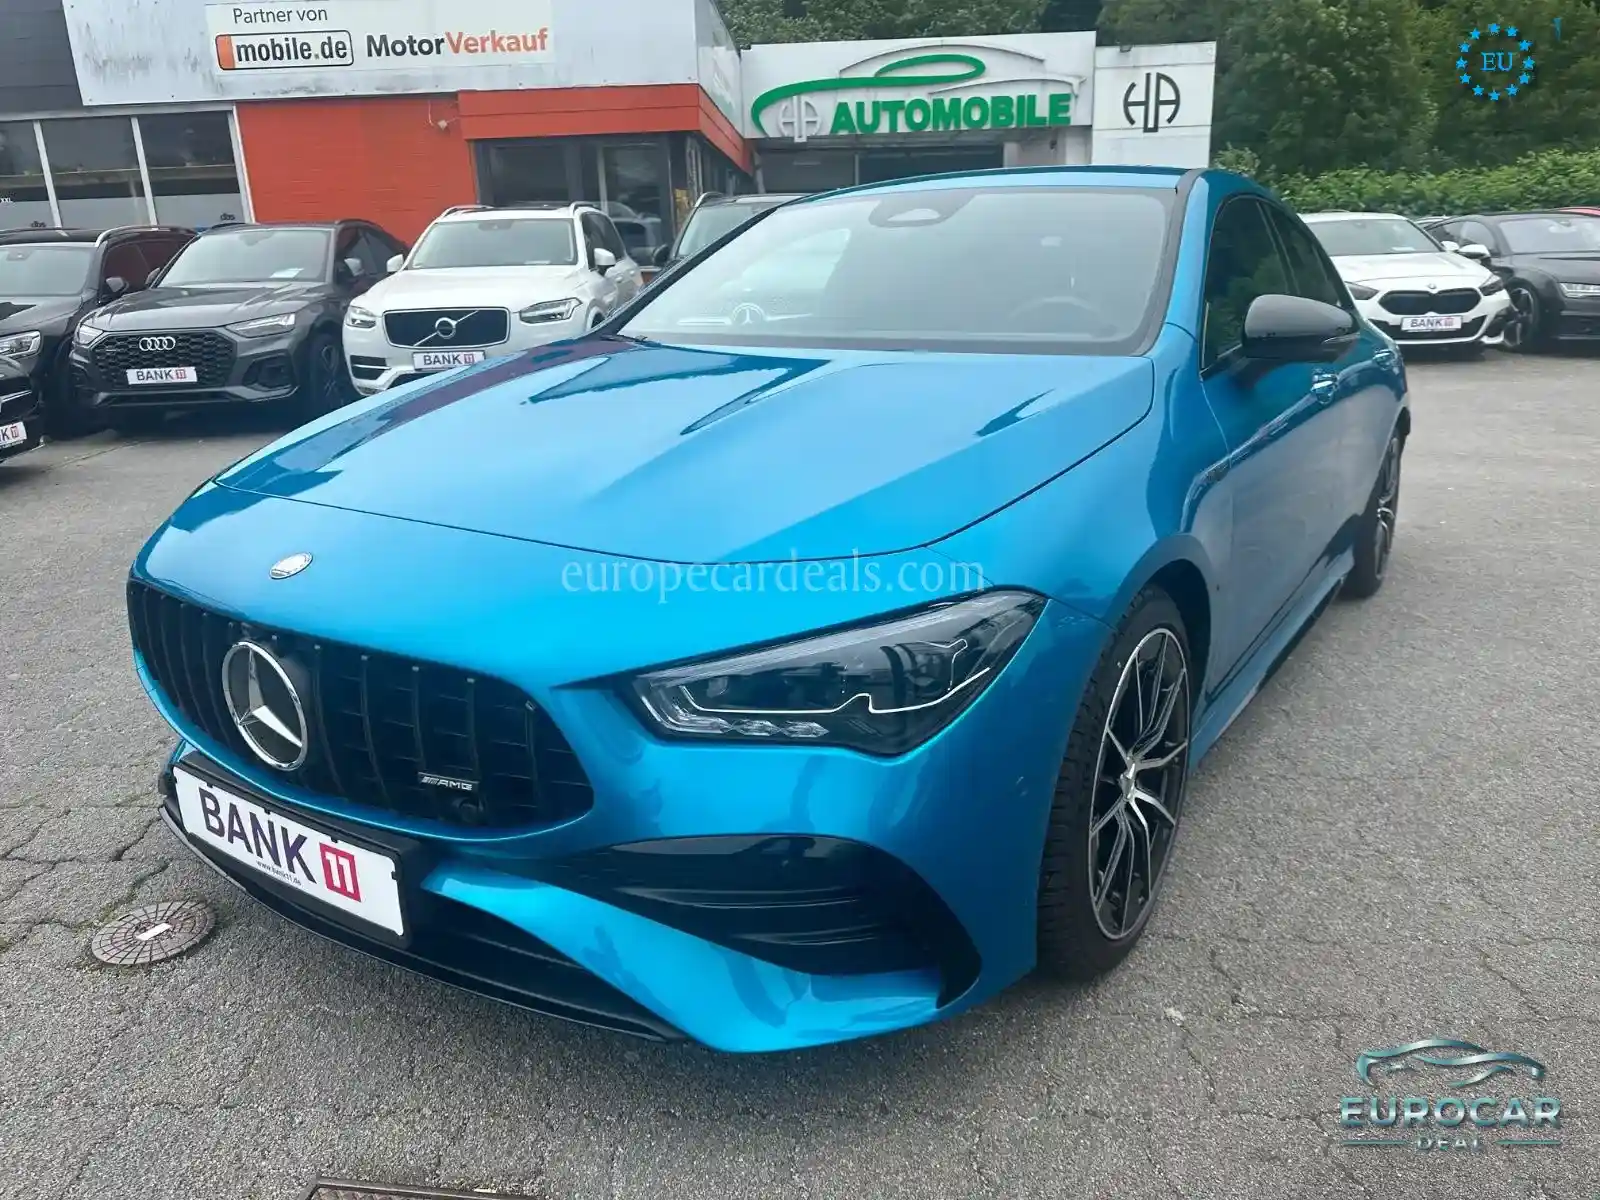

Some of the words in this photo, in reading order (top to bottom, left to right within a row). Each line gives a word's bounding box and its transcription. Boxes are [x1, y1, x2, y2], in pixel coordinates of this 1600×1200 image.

[233, 6, 293, 24] Partner
[297, 8, 328, 21] von
[236, 36, 348, 63] mobile.de
[829, 93, 1072, 134] AUTOMOBILE
[1410, 318, 1442, 328] BANK
[423, 354, 462, 366] BANK
[136, 369, 174, 381] BANK
[199, 787, 318, 884] BANK
[323, 850, 356, 896] 11
